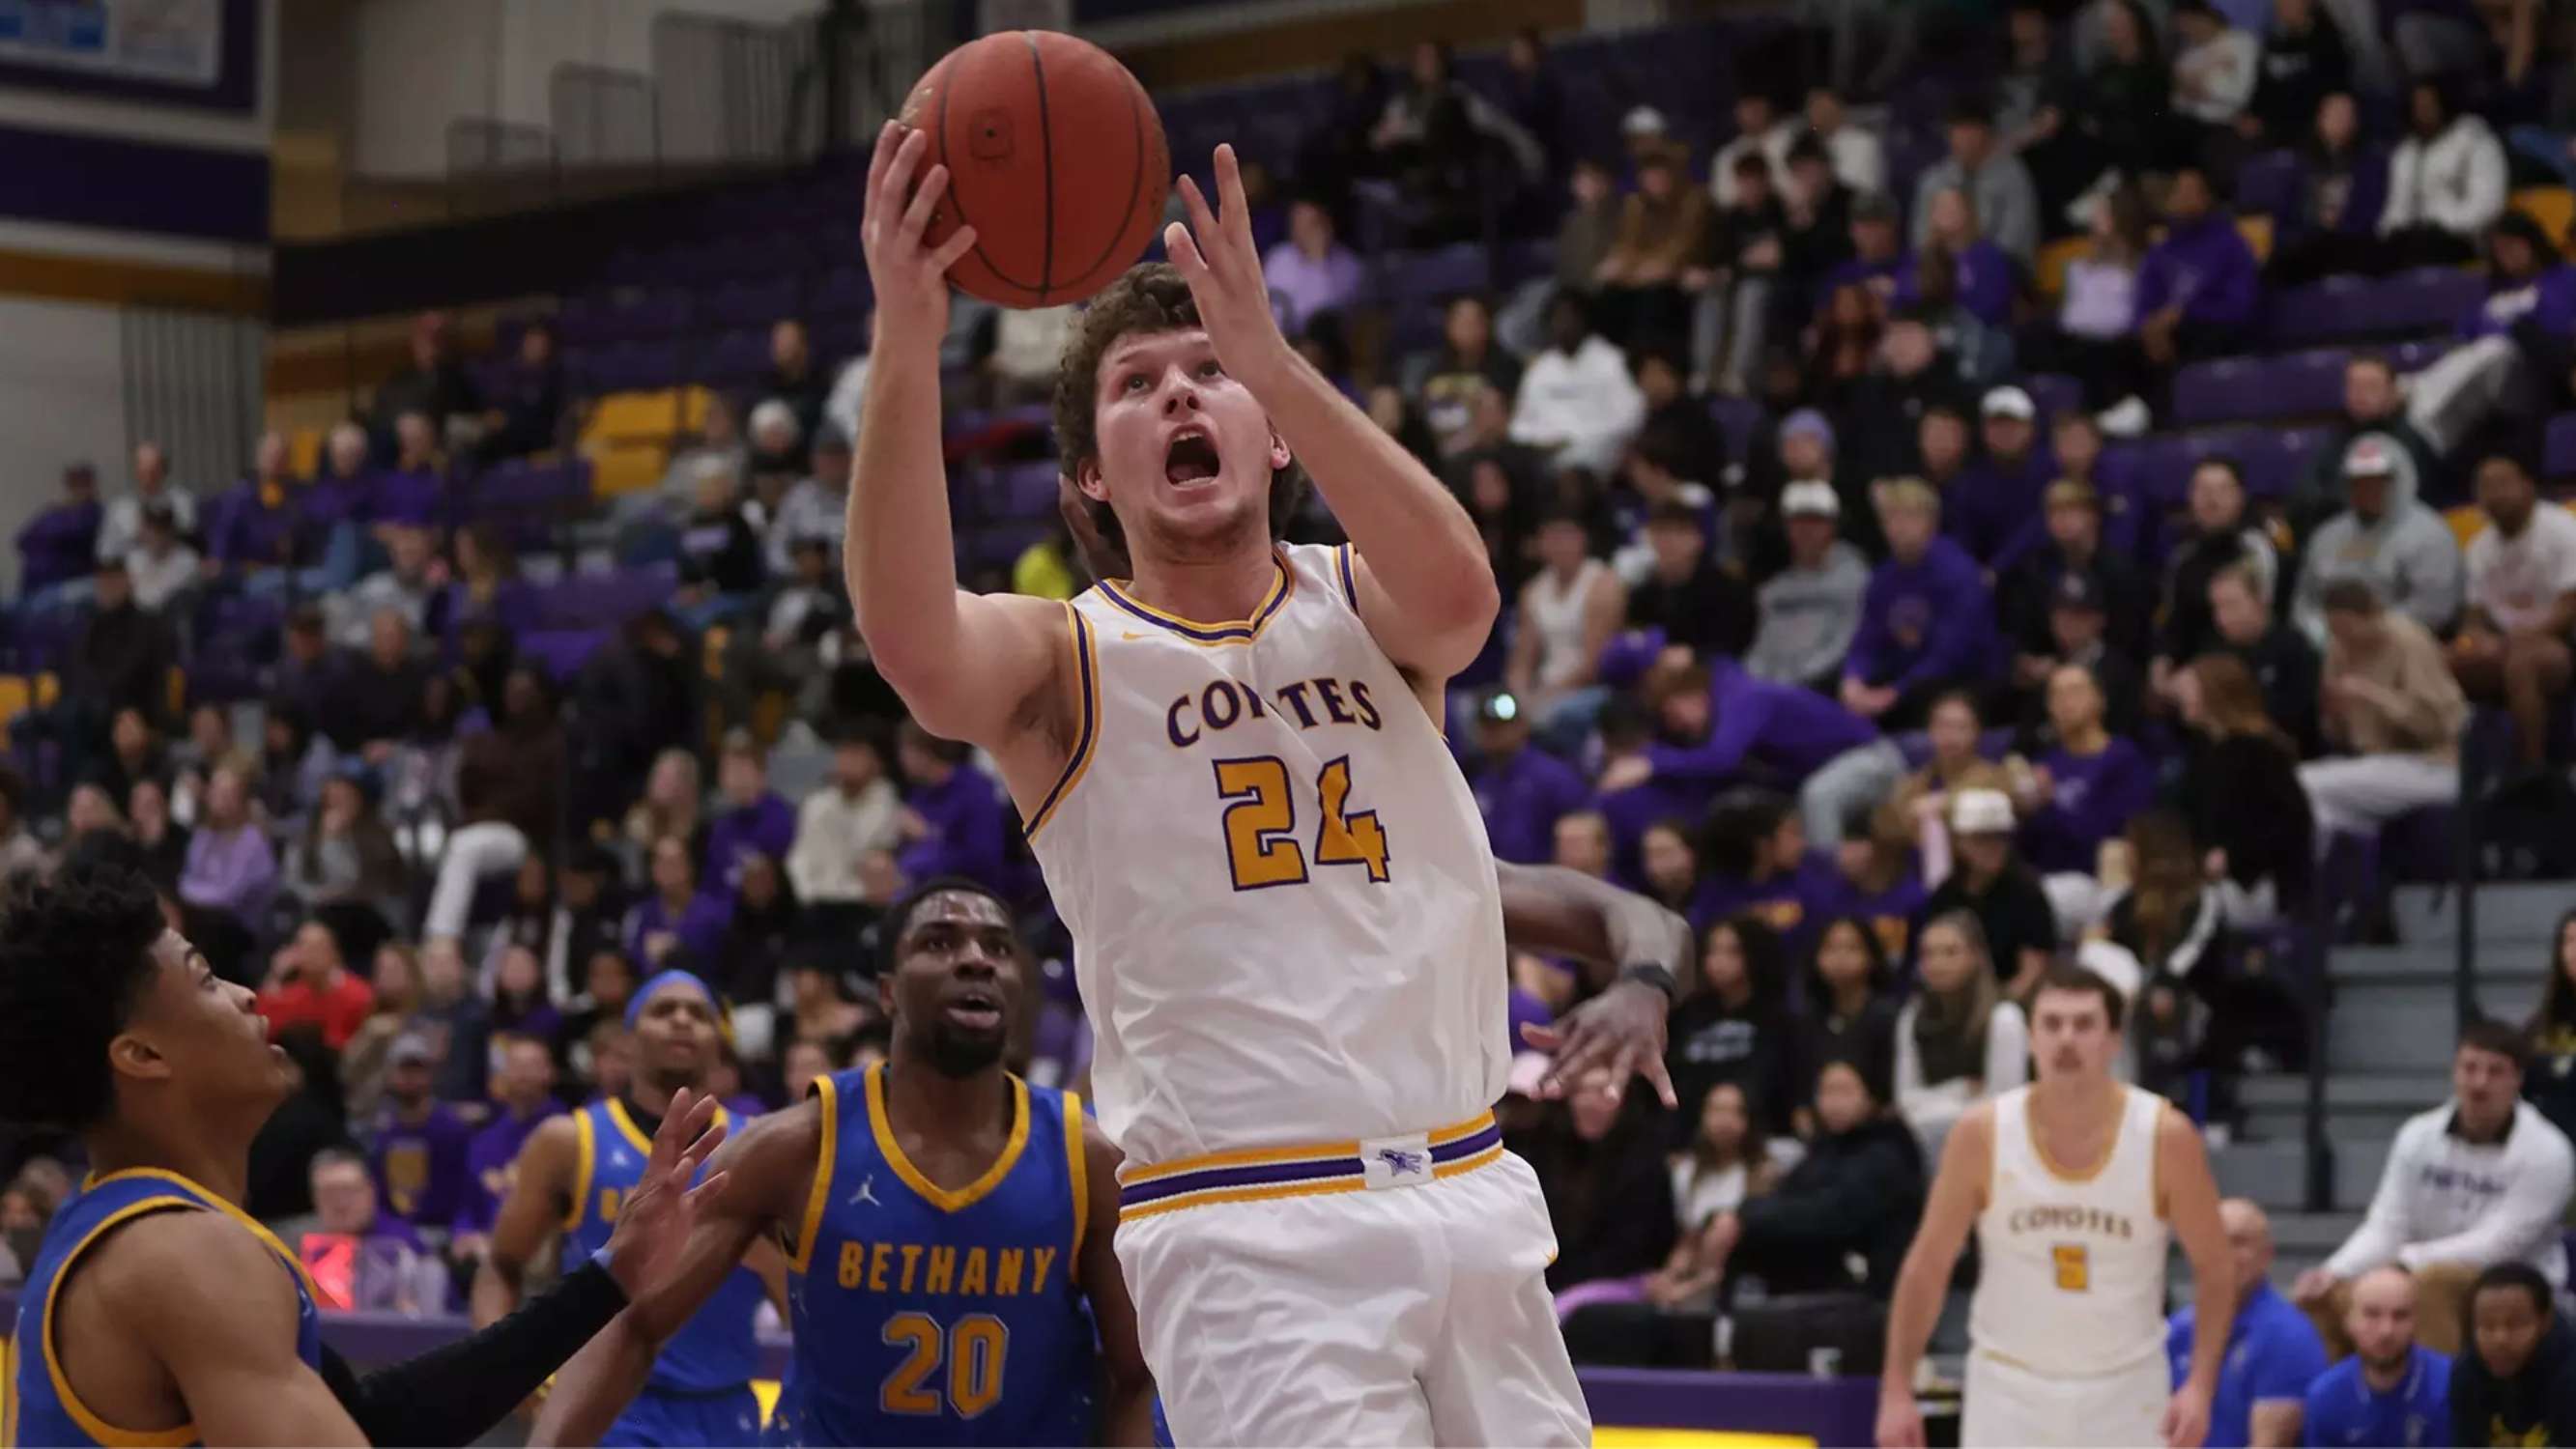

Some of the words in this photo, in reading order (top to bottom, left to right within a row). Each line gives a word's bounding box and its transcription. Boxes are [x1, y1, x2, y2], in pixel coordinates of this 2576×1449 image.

[1166, 678, 1382, 748] COYTES
[1212, 754, 1390, 892] 24
[2008, 1204, 2134, 1239] COYOTES
[837, 1240, 1056, 1295] BETHANY
[879, 1311, 1010, 1420] 20
